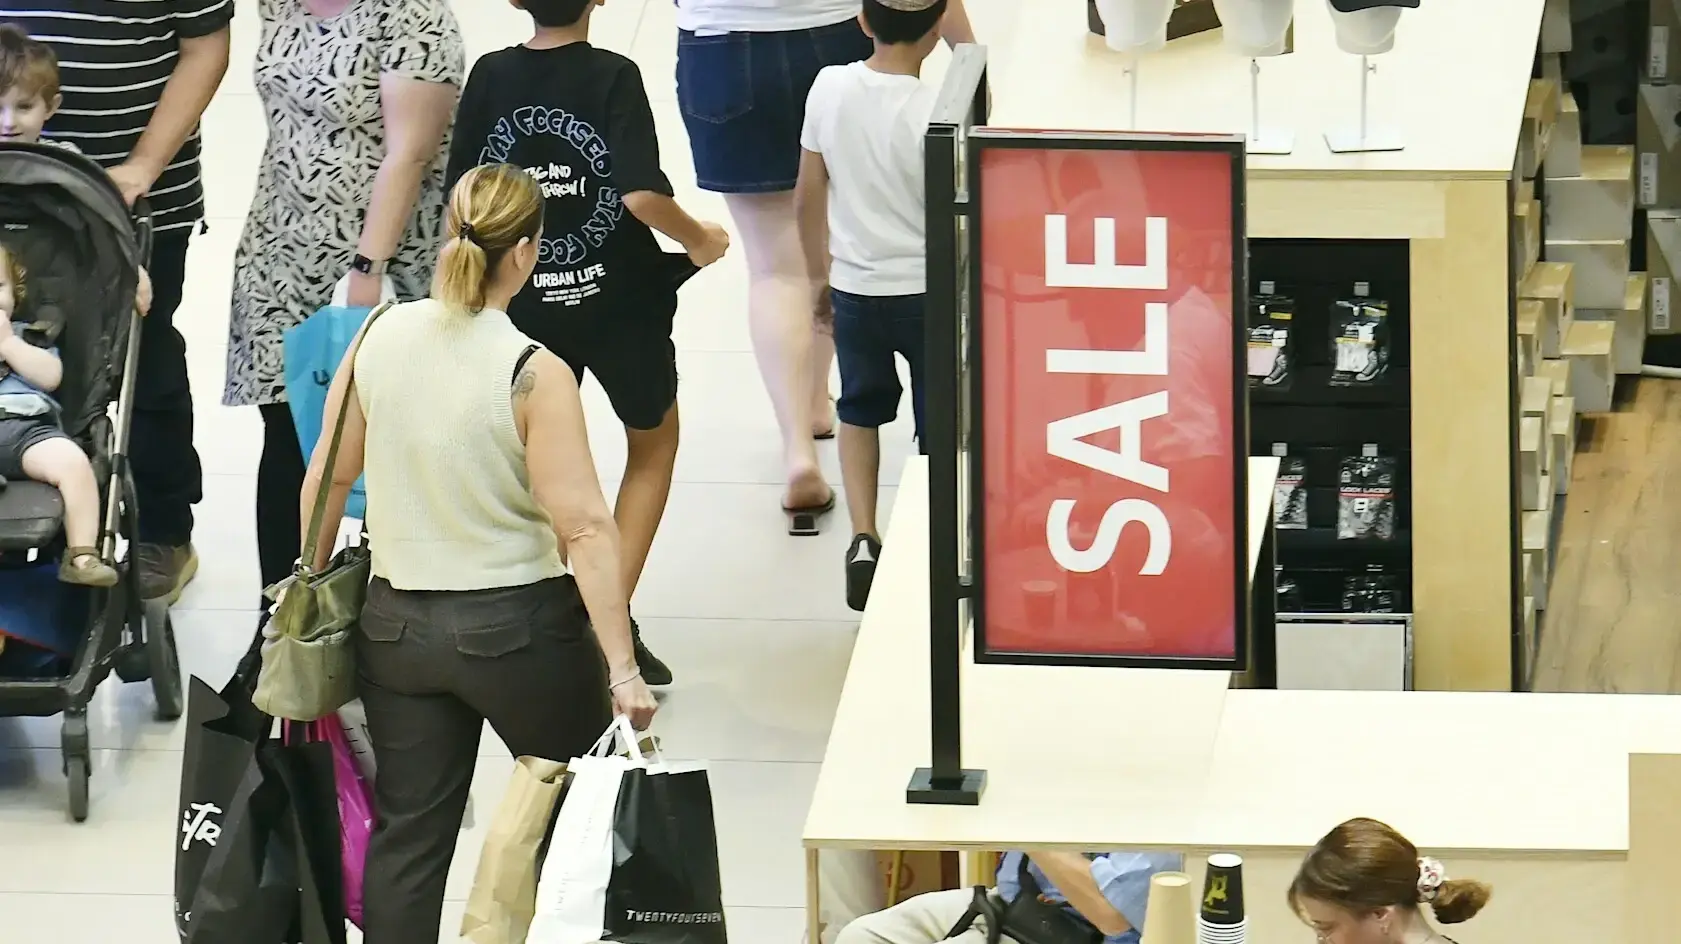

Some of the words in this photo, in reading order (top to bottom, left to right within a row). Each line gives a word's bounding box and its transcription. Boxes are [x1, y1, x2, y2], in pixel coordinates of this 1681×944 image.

[478, 117, 516, 165] TAY
[513, 106, 612, 177] FOCUSED
[548, 162, 571, 179] AND
[581, 186, 624, 248] STAY
[533, 271, 576, 288] URBAN
[576, 263, 606, 283] LIFE
[1045, 214, 1171, 575] SALE
[626, 909, 722, 924] TWENTYFOURSEVEN
